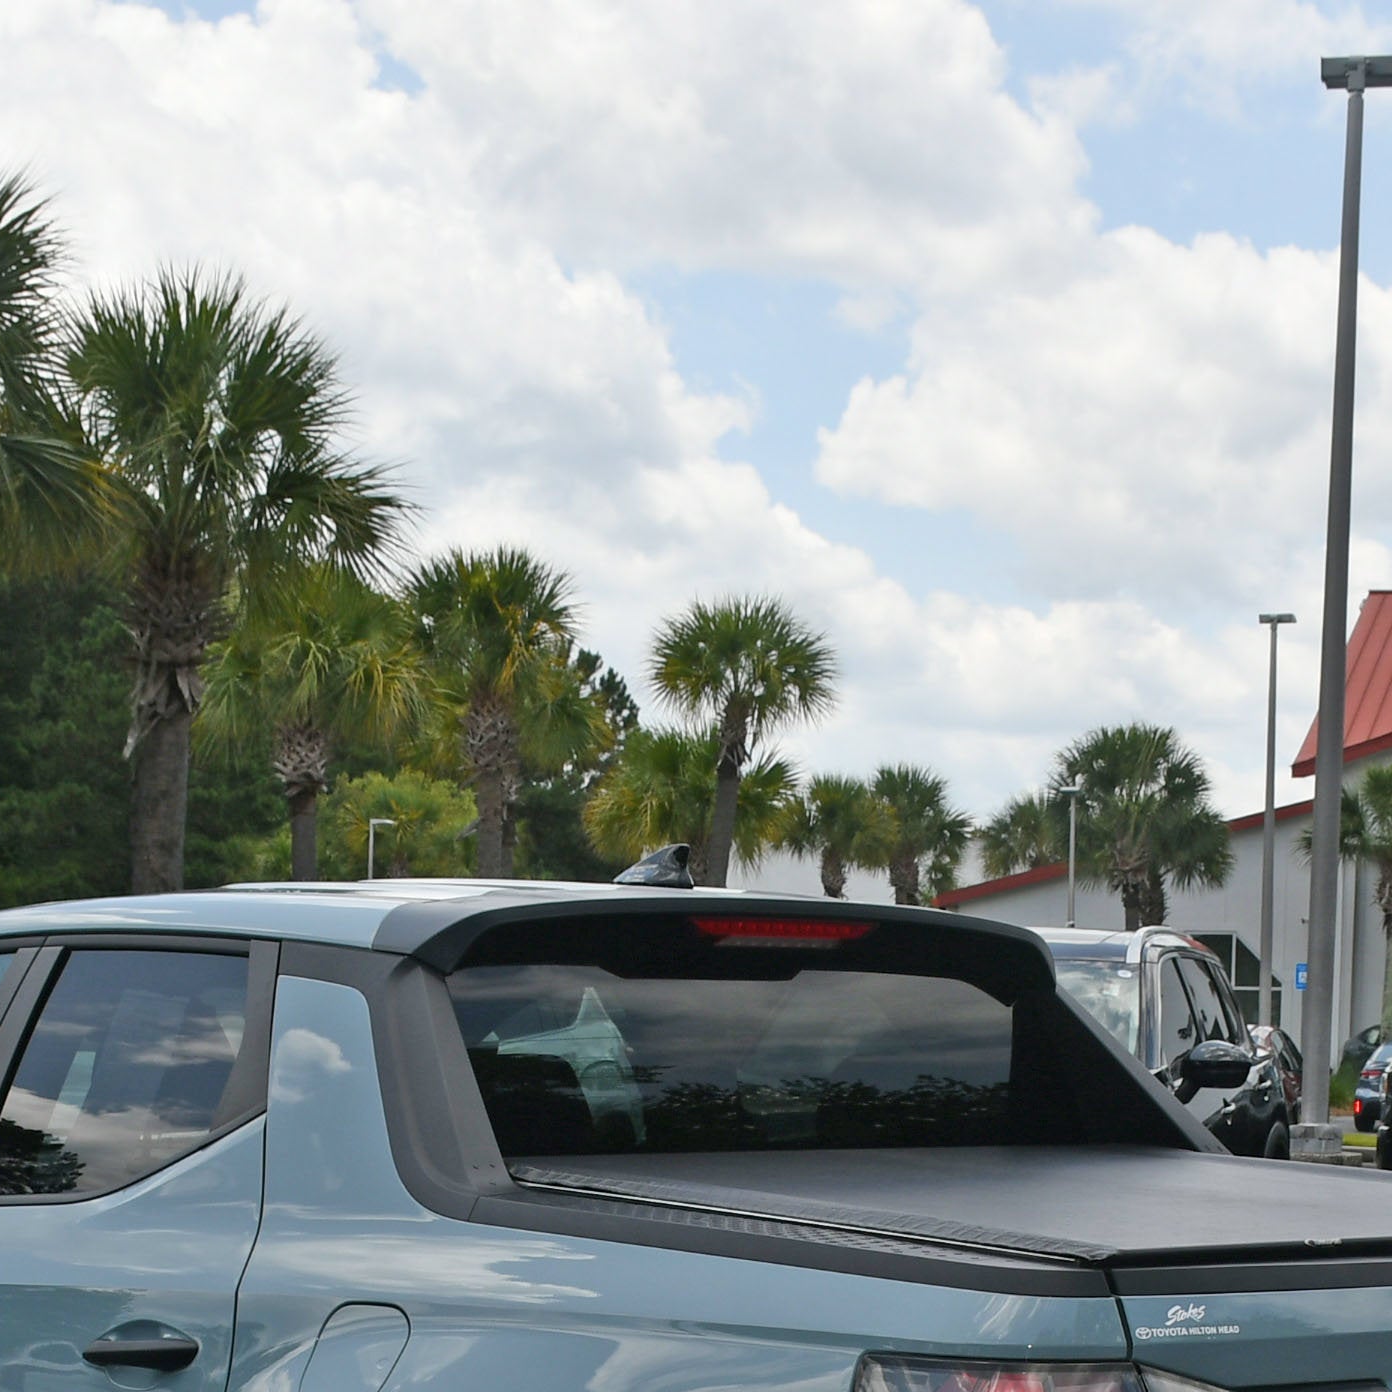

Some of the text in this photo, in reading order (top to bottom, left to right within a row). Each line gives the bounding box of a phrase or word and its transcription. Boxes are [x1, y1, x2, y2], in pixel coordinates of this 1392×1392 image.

[1164, 1303, 1206, 1326] Stokes
[1151, 1325, 1240, 1338] TOYOTA HILTON HEAD
